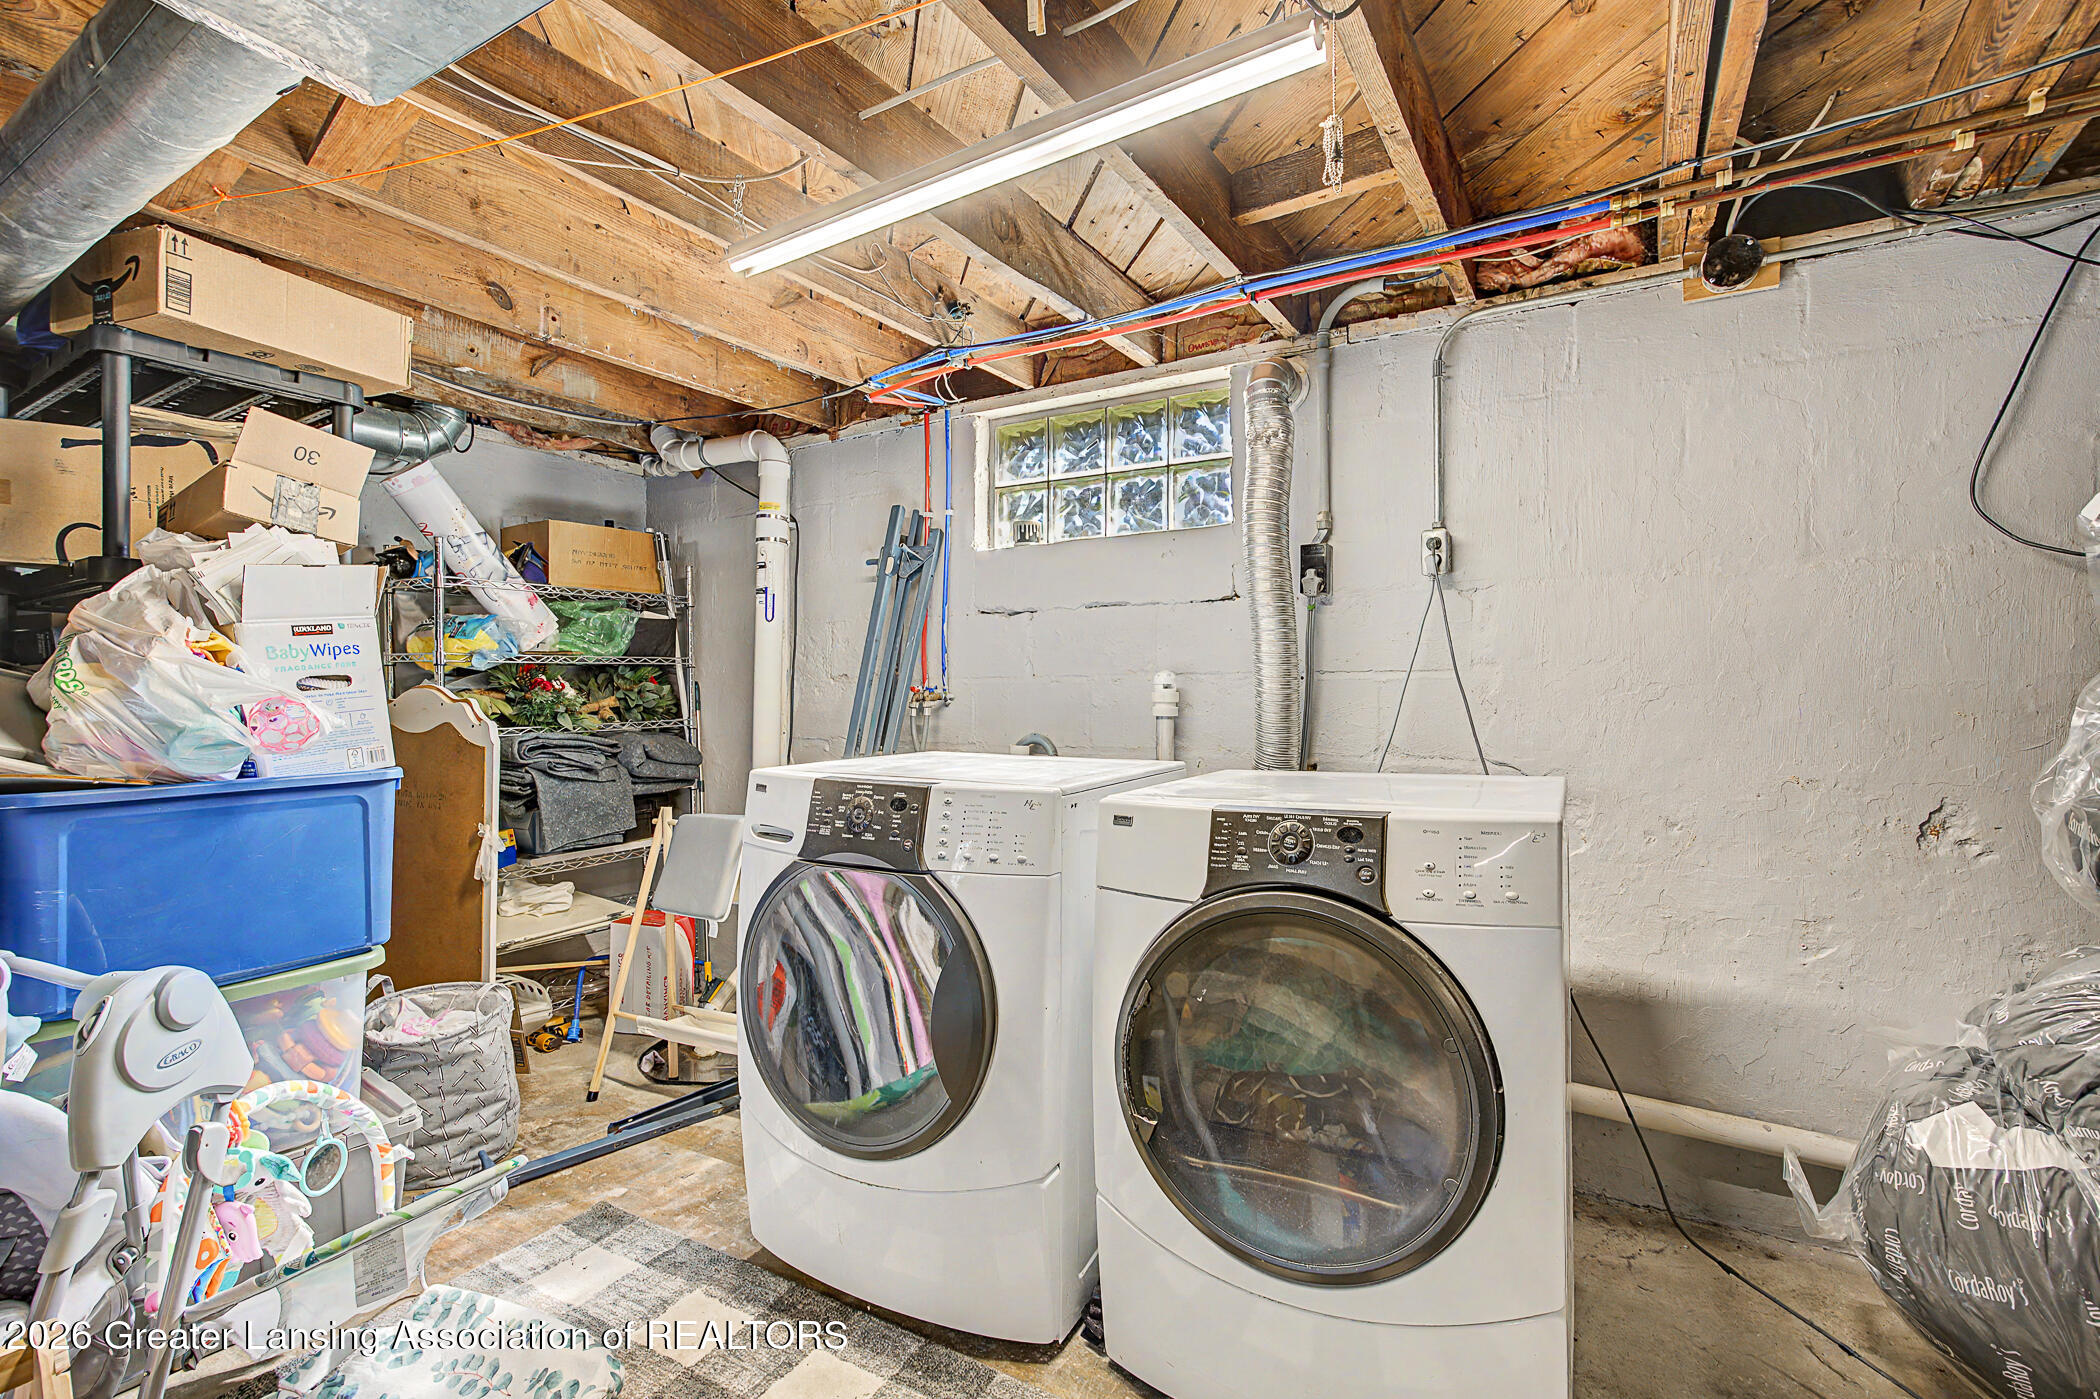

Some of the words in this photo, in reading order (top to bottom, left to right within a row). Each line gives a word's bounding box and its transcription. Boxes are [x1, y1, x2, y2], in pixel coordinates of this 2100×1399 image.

[293, 445, 321, 466] 30
[274, 663, 332, 673] FRAGRANCE
[163, 1042, 198, 1065] GRACO
[1948, 1268, 2029, 1311] CordaRoy's
